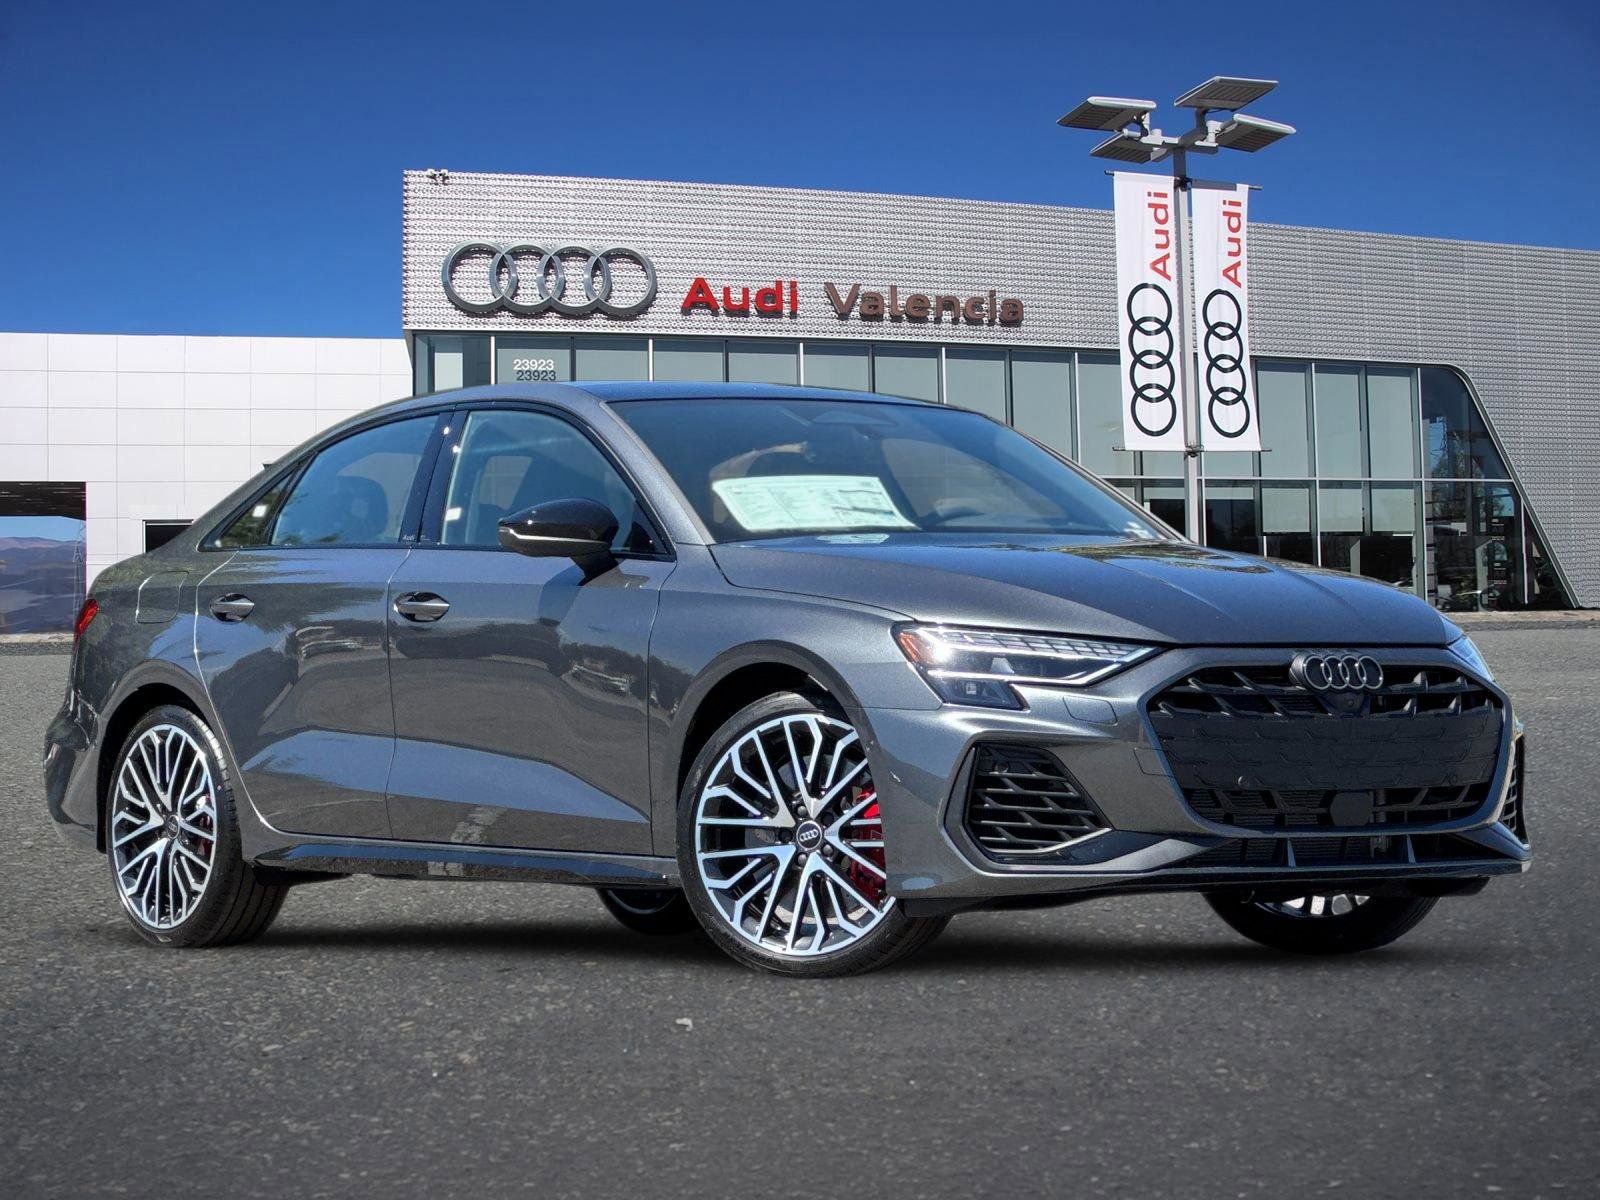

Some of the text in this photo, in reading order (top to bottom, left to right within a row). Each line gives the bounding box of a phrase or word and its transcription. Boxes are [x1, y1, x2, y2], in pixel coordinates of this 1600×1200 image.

[1147, 191, 1172, 282] Audi
[1222, 199, 1242, 289] Audi
[681, 277, 1025, 326] Audi Valencia
[513, 358, 554, 370] 23923
[516, 370, 556, 381] 23923
